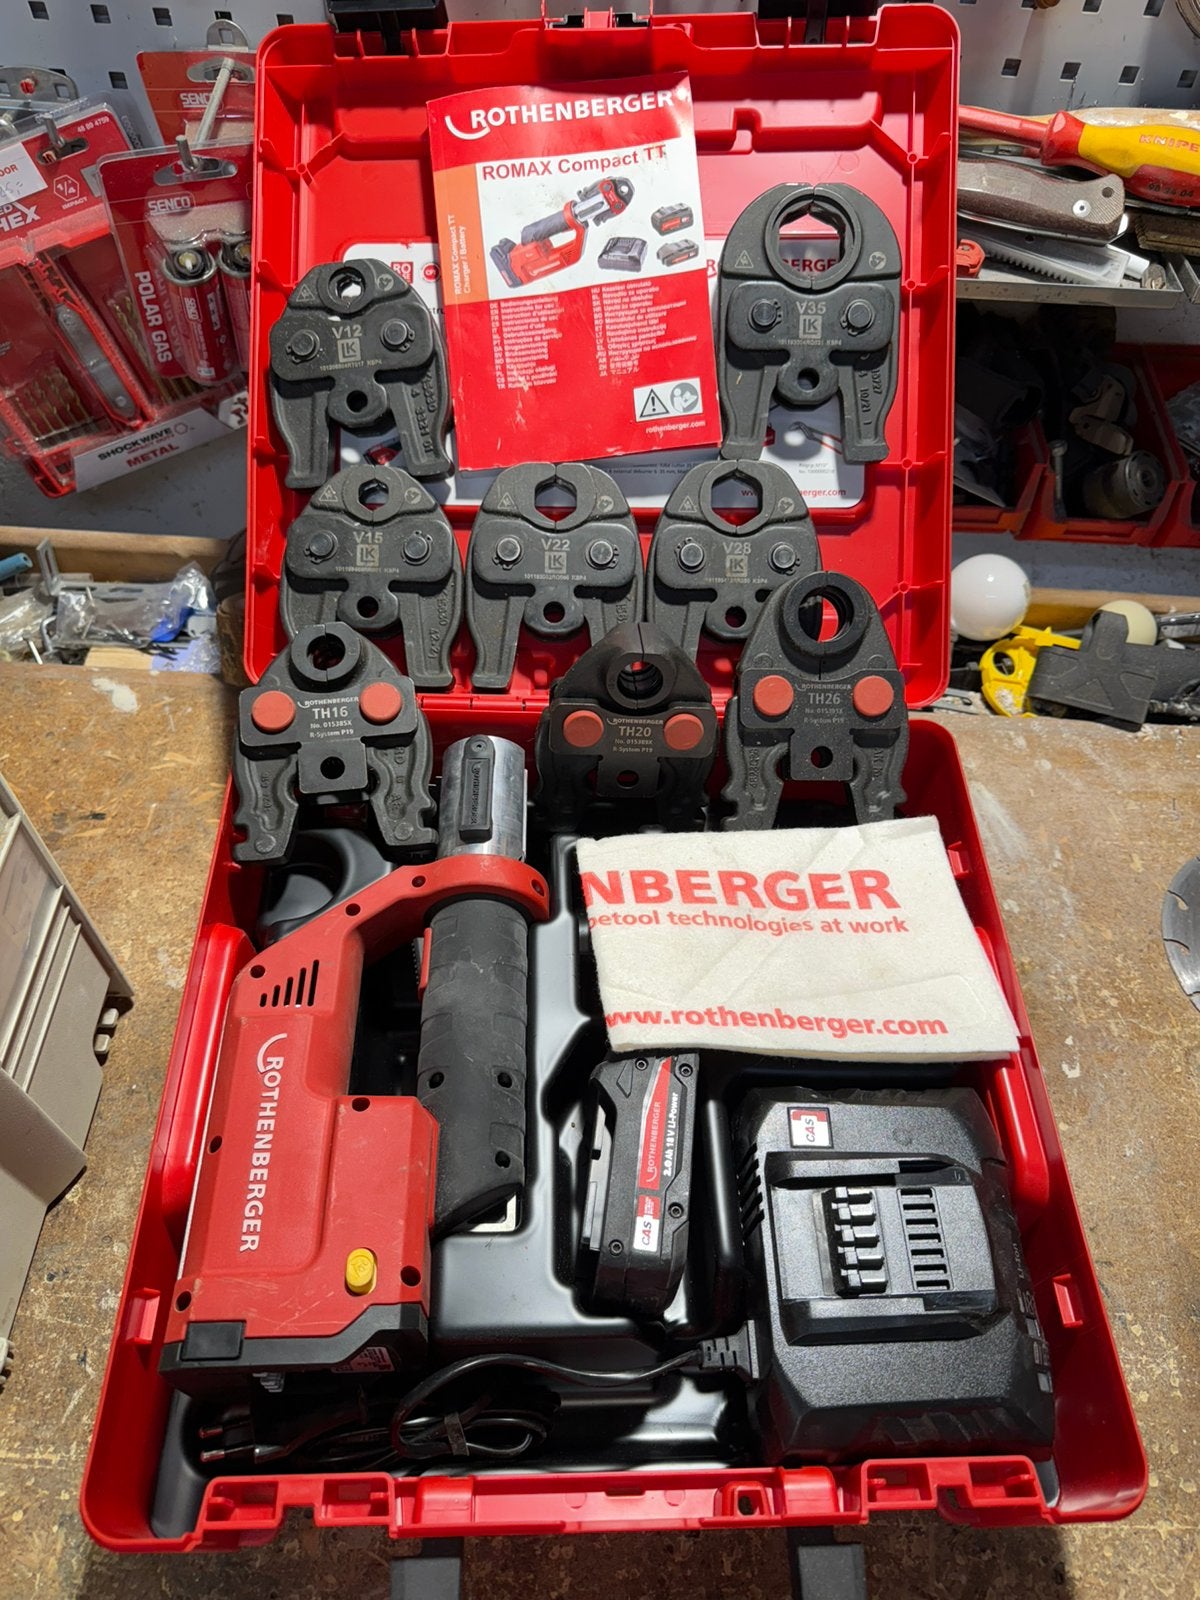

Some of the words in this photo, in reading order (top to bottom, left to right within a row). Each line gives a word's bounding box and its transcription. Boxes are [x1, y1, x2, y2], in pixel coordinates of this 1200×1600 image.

[180, 92, 214, 106] SENC
[469, 89, 675, 130] ROTHENBERGER
[482, 160, 553, 181] ROMAX
[557, 150, 639, 174] Compact
[643, 145, 666, 161] TT
[147, 196, 191, 212] SENCO
[796, 300, 826, 315] V35
[135, 271, 163, 327] POLAR
[151, 330, 172, 362] GAS
[332, 324, 362, 339] V12
[645, 420, 706, 434] rothenberger.com
[97, 427, 173, 461] SHOCKWAVE
[126, 443, 180, 468] METAL
[353, 531, 383, 544] V15
[541, 538, 570, 551] V22
[723, 542, 752, 554] V28
[304, 696, 360, 706] ROTHENBERGER
[808, 692, 841, 705] TH26
[312, 706, 349, 719] TH16
[619, 726, 652, 737] TH20
[668, 909, 813, 937] technologies
[819, 917, 843, 934] at
[848, 916, 909, 934] work
[604, 1005, 949, 1039] www.rothenberger.com
[647, 1101, 661, 1173] ROTHENBERGER
[805, 1117, 816, 1143] CAS
[239, 1056, 285, 1252] ROTHENBERGER
[641, 1221, 652, 1246] CAS
